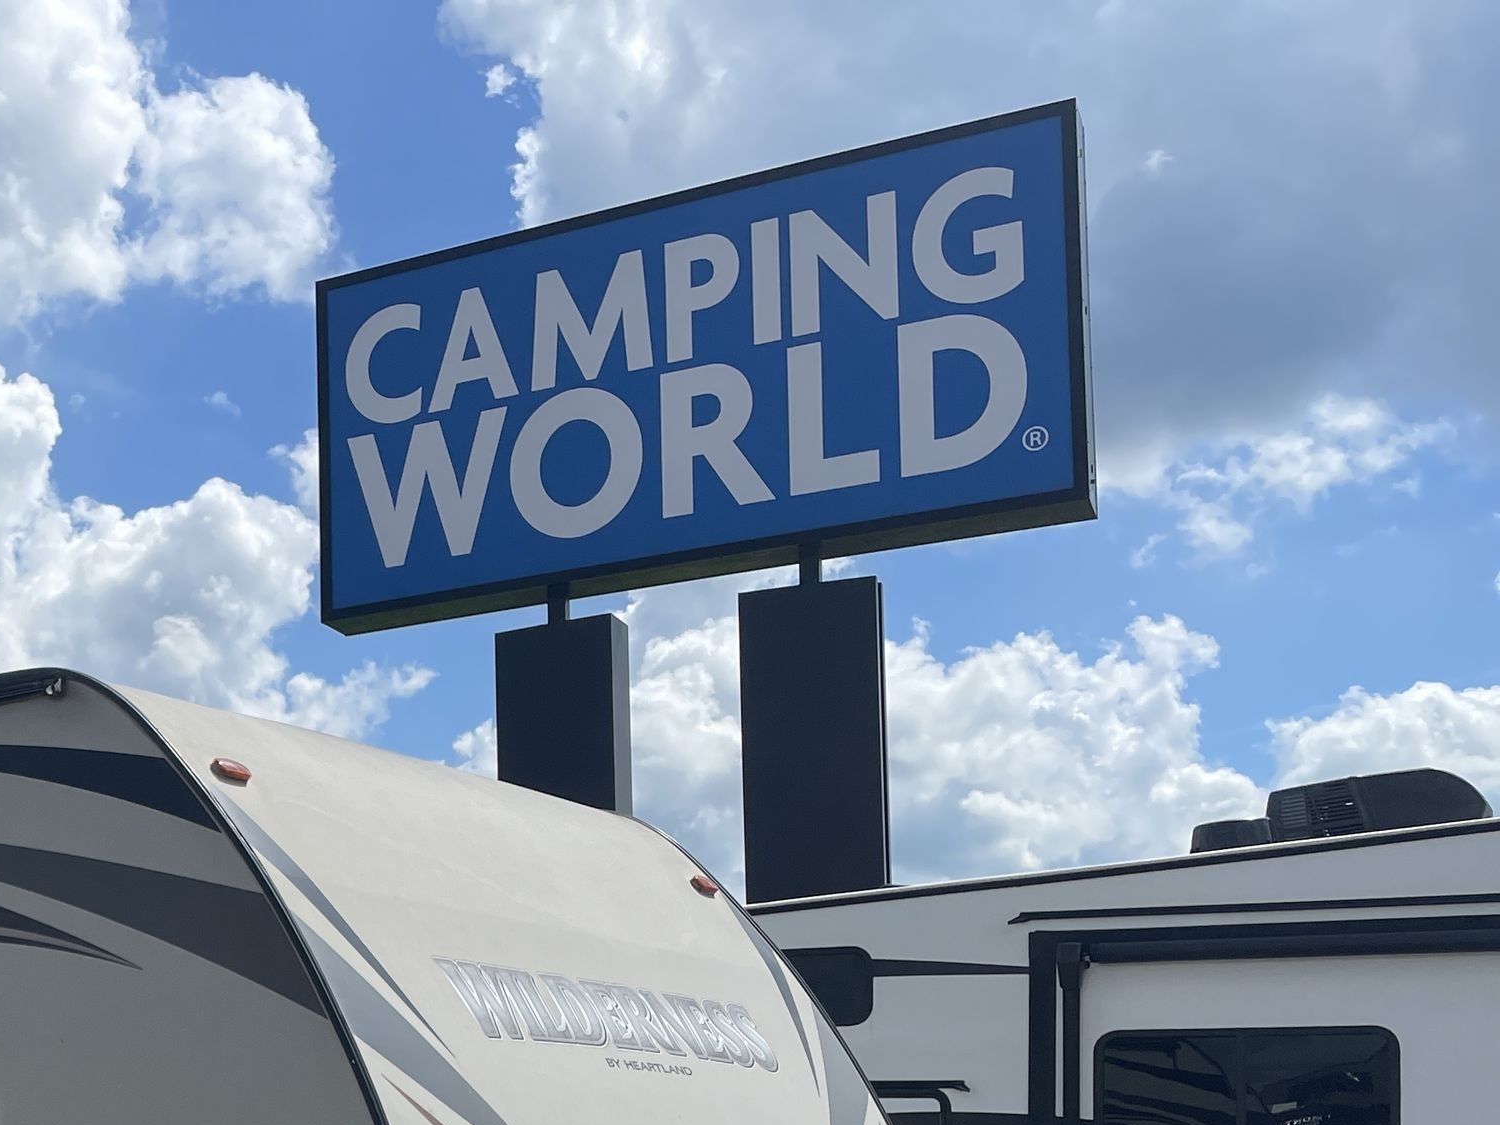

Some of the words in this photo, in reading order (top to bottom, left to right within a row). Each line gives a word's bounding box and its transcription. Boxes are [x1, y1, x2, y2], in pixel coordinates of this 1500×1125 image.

[344, 166, 1025, 424] CAMPING
[346, 313, 1028, 568] WORLD
[431, 954, 779, 1074] WILDERNESS
[605, 1058, 621, 1069] BY
[624, 1059, 692, 1076] HEARTLAND
